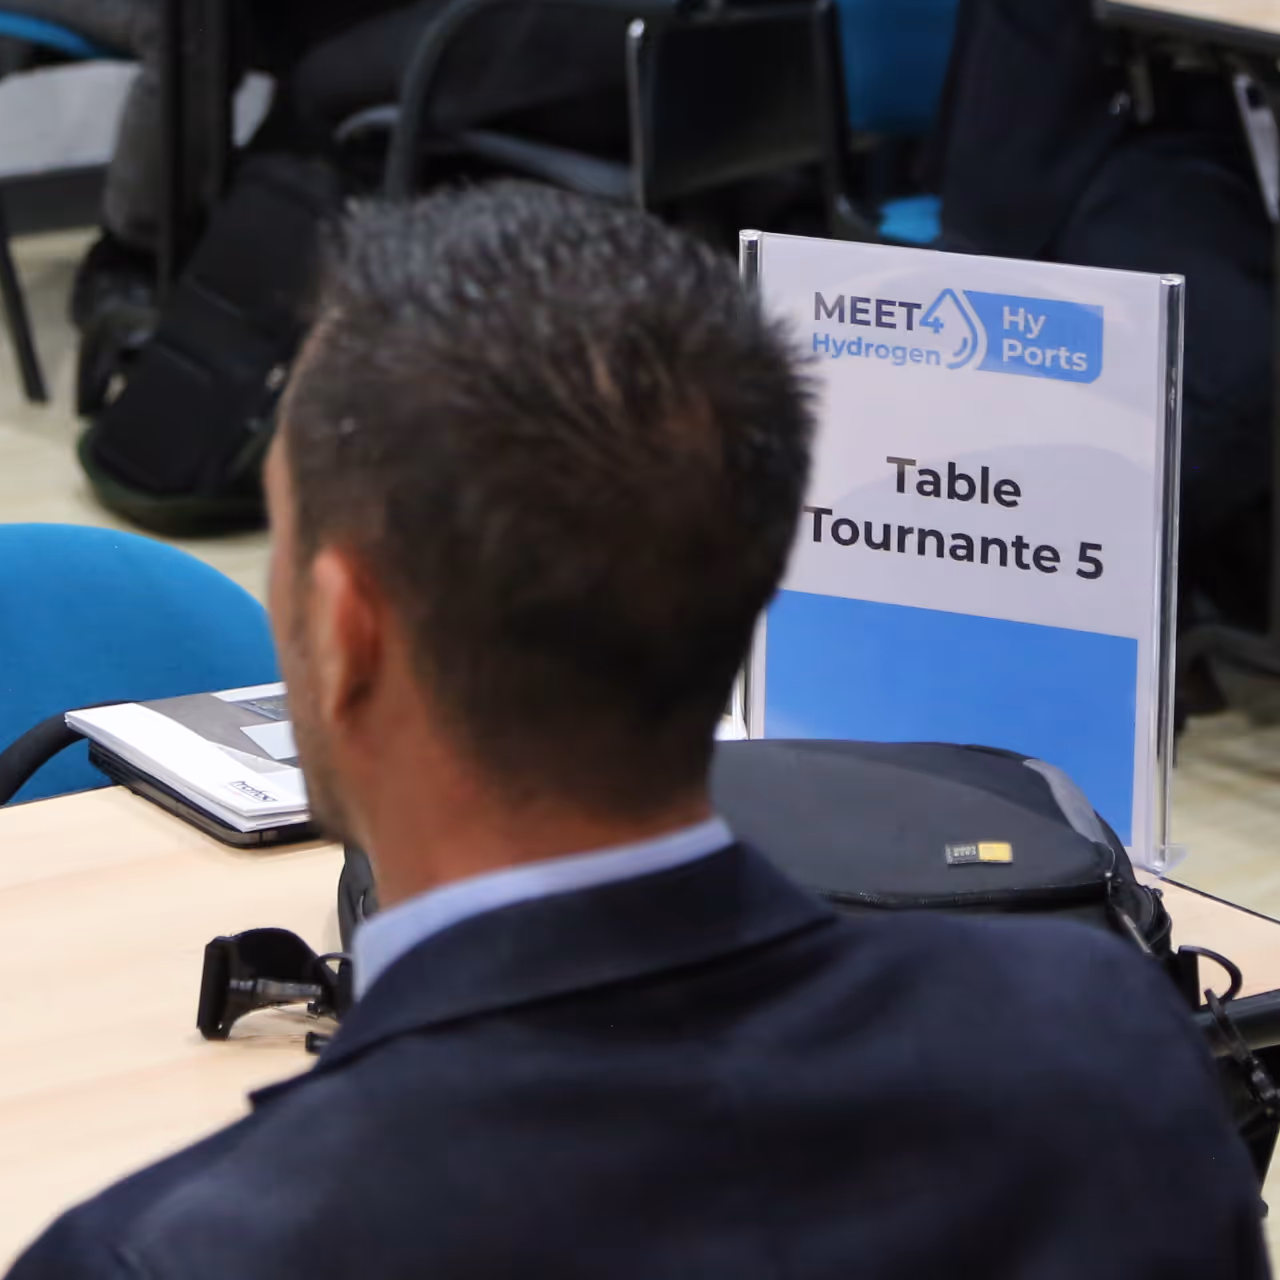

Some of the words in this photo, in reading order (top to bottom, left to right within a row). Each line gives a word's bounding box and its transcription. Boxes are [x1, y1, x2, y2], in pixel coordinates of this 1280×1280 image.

[1002, 305, 1047, 339] Hy
[813, 332, 941, 366] Hydrogen
[1002, 338, 1088, 372] Ports
[886, 455, 1022, 508] Table
[803, 506, 1061, 573] Tournante
[1076, 541, 1104, 580] 5
